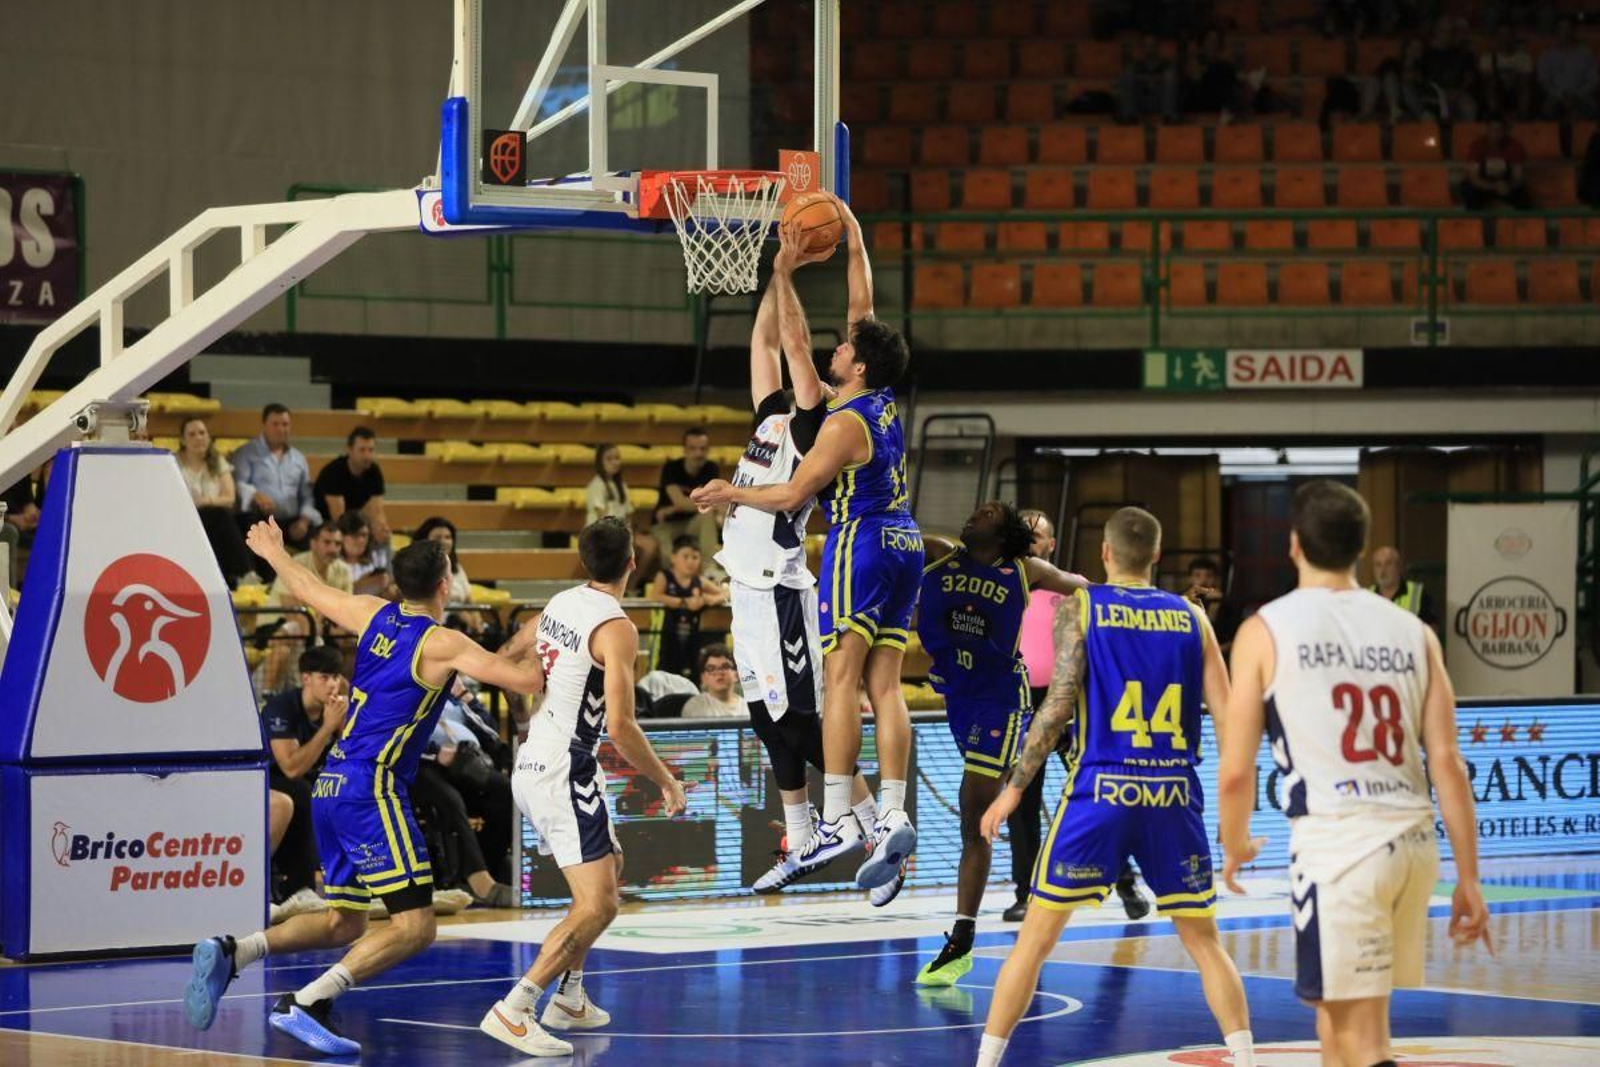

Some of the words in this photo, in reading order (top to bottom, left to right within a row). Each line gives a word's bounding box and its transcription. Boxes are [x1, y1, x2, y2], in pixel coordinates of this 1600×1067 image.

[1233, 354, 1354, 382] SAIDA
[1477, 596, 1547, 609] ARROCERIA
[952, 620, 984, 636] Galicia
[1096, 603, 1192, 633] LEIMANIS
[1472, 611, 1549, 640] GIJON
[956, 648, 974, 671] 10
[1298, 642, 1348, 670] RAFA
[1351, 646, 1416, 675] LISBOA
[1110, 680, 1188, 750] 44
[1331, 682, 1405, 767] 28
[1100, 780, 1186, 807] ROMA
[1477, 816, 1556, 838] OTELES
[70, 831, 243, 861] BricoCentro
[111, 861, 245, 891] Paradelo
